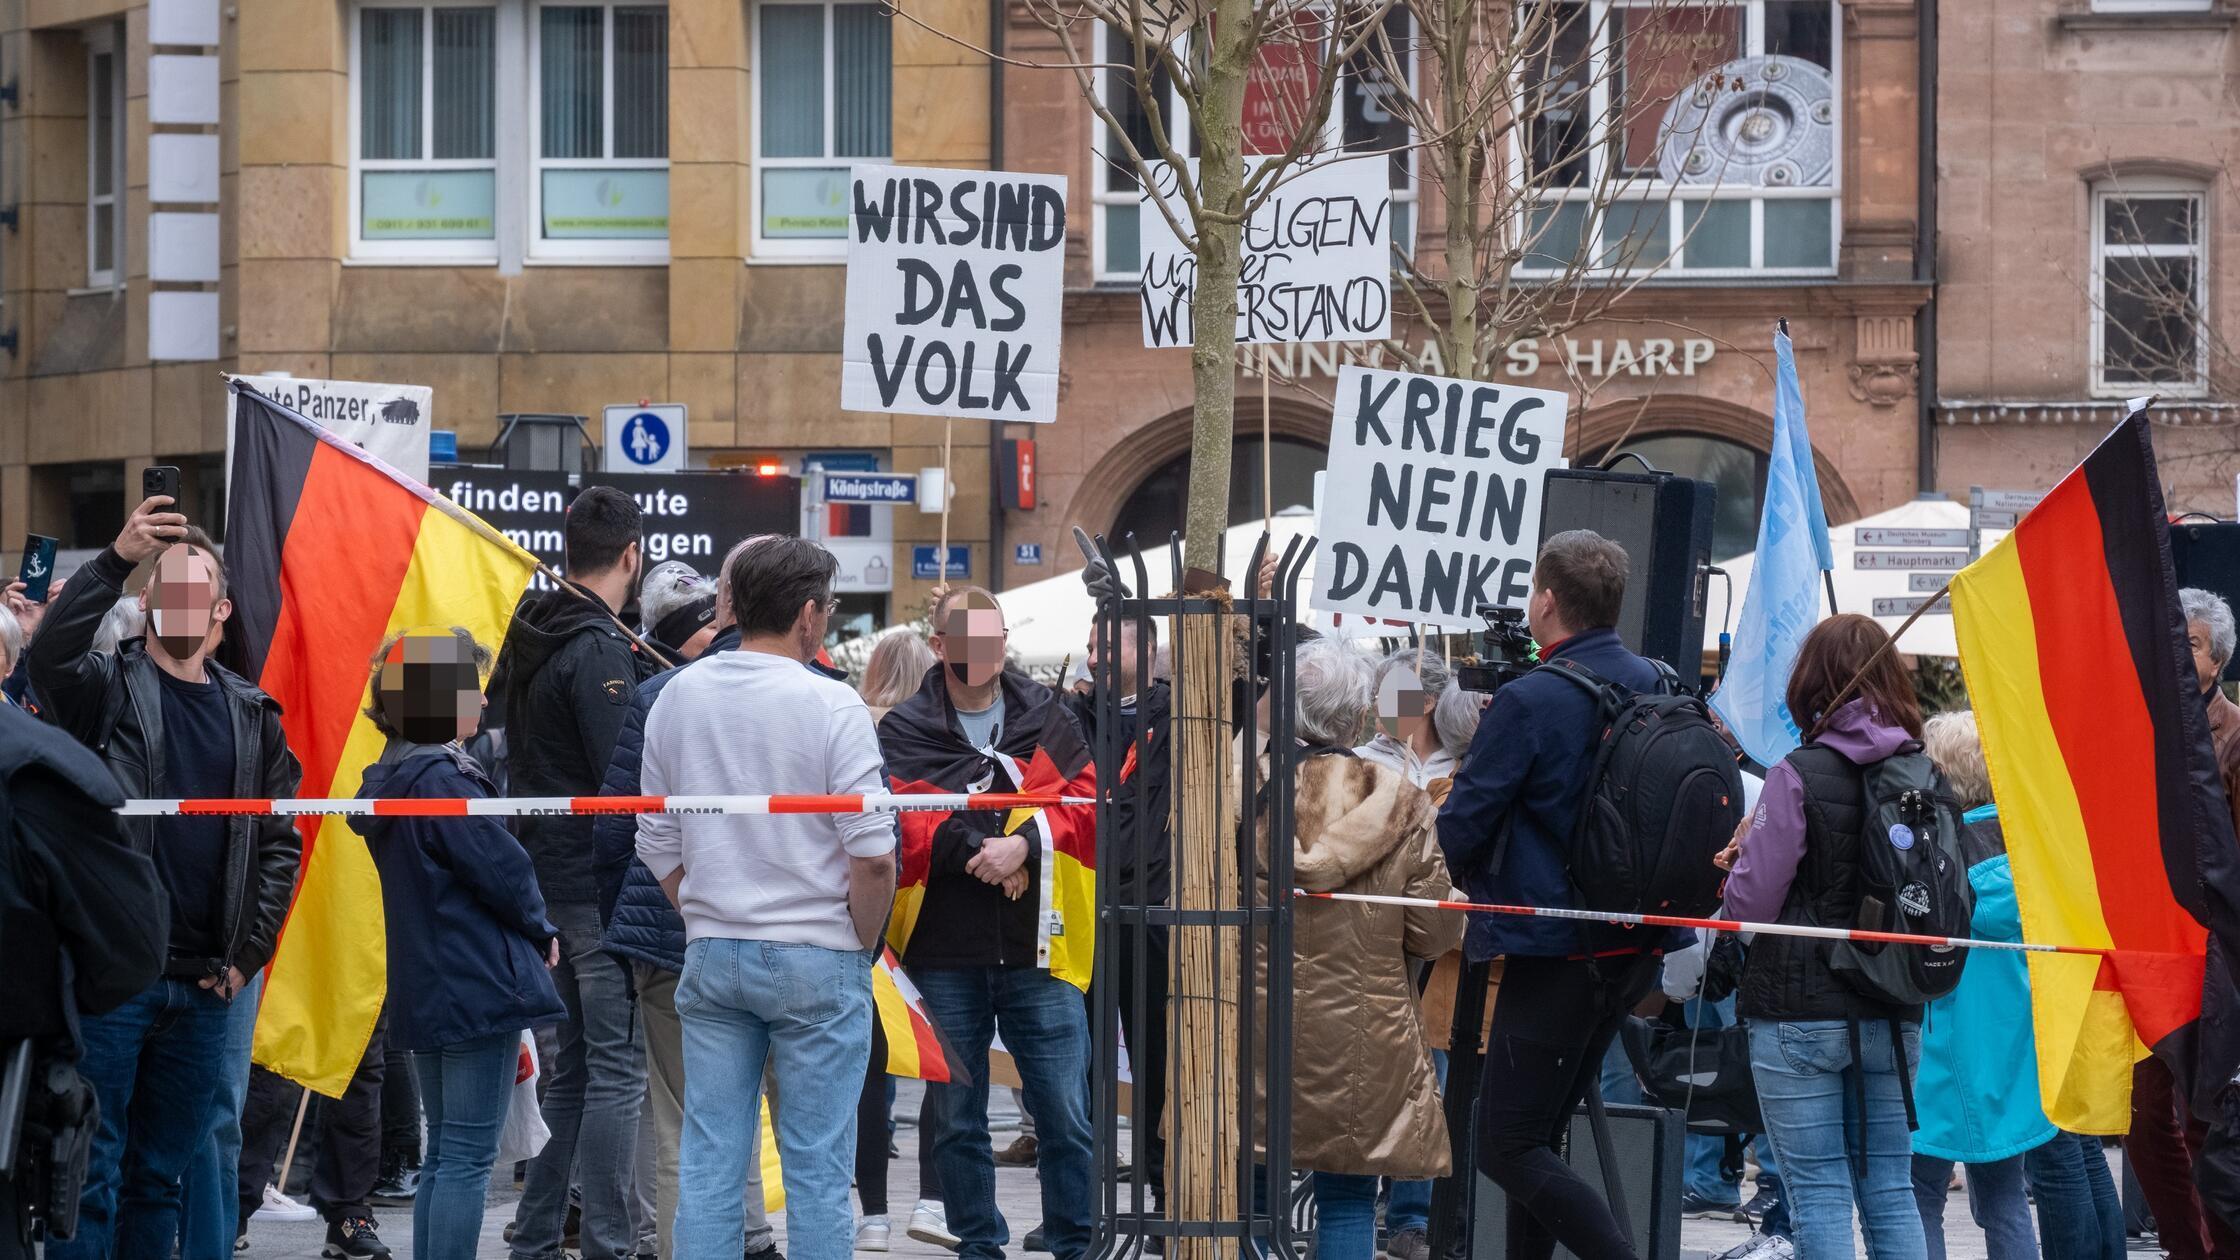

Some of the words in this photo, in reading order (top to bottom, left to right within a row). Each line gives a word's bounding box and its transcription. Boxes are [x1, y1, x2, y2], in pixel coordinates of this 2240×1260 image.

[1190, 196, 1389, 256] ÜGEN
[895, 257, 1026, 333] DAS
[866, 332, 1032, 412] VOLK
[1566, 338, 1716, 377] HARP
[298, 384, 376, 426] Panzer,
[1355, 374, 1546, 465] KRIEG
[449, 481, 564, 512] finden
[829, 477, 909, 500] Königstraße
[1367, 462, 1528, 546] NEIN
[1887, 556, 1956, 568] Hauptmarkt
